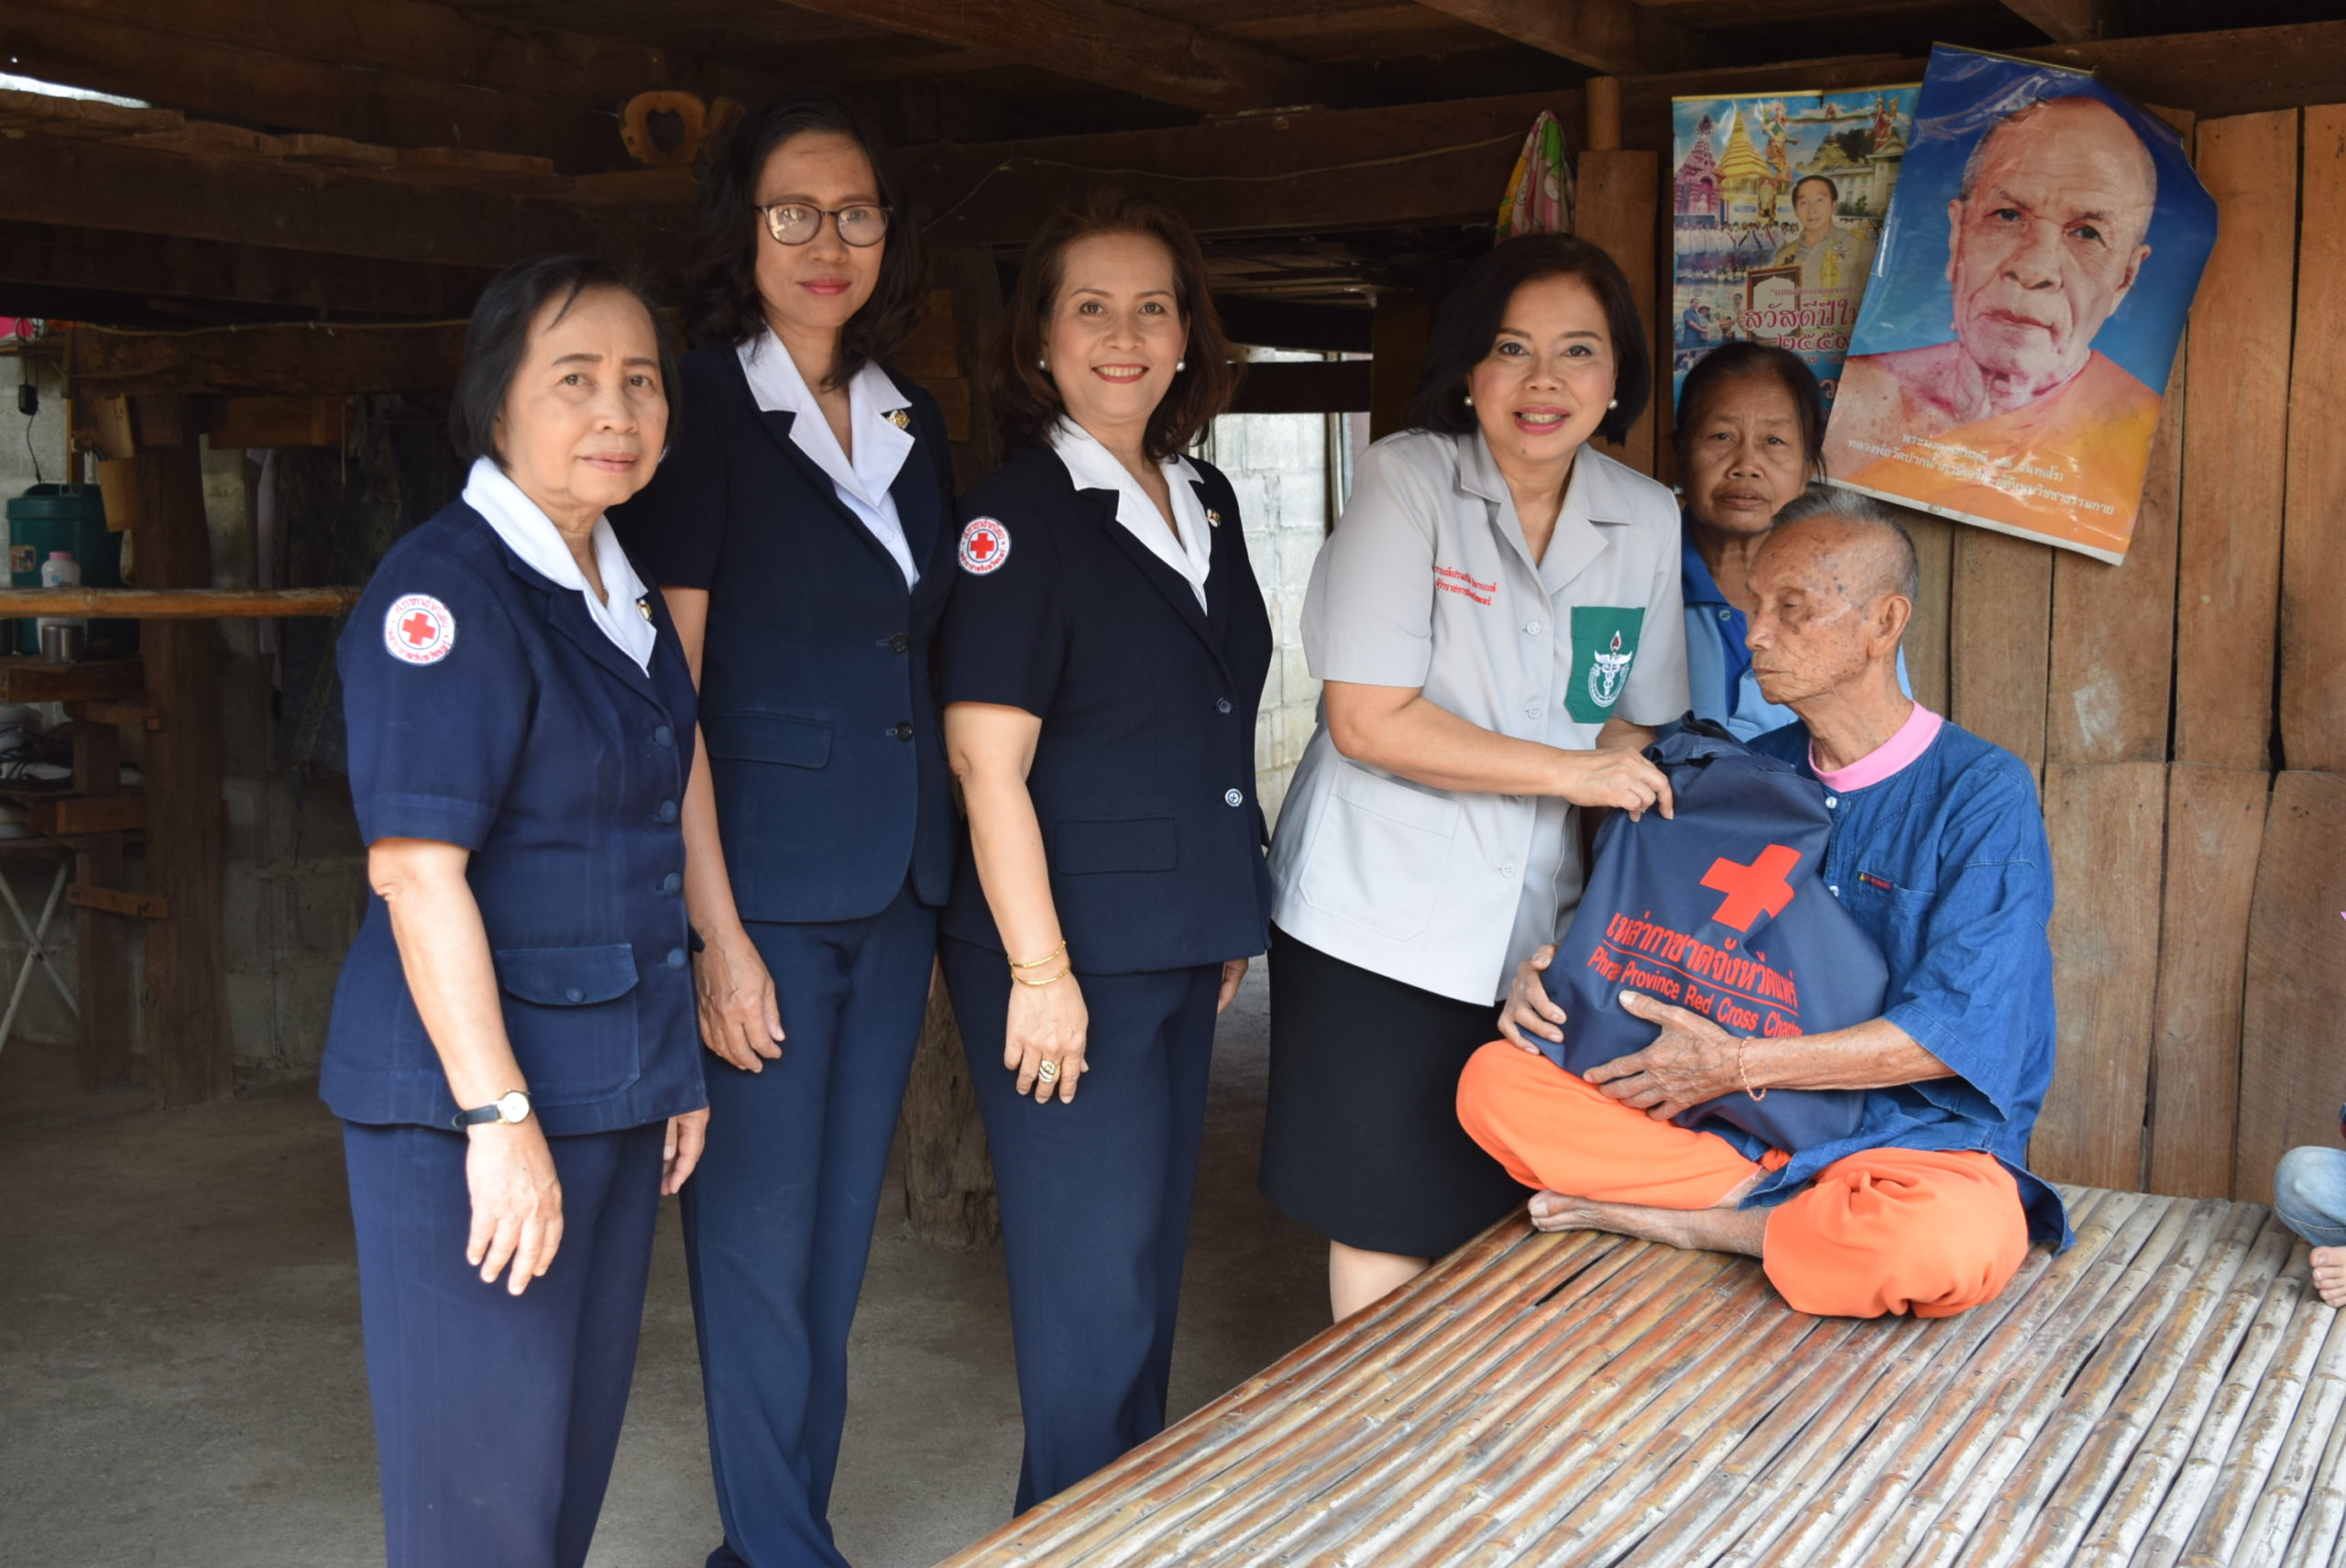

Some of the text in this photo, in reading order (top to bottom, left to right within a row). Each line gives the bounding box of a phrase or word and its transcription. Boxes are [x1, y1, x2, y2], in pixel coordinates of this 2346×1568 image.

[1620, 959, 1681, 1000] Province
[1683, 983, 1716, 1015] Red
[1716, 996, 1760, 1031] Cross
